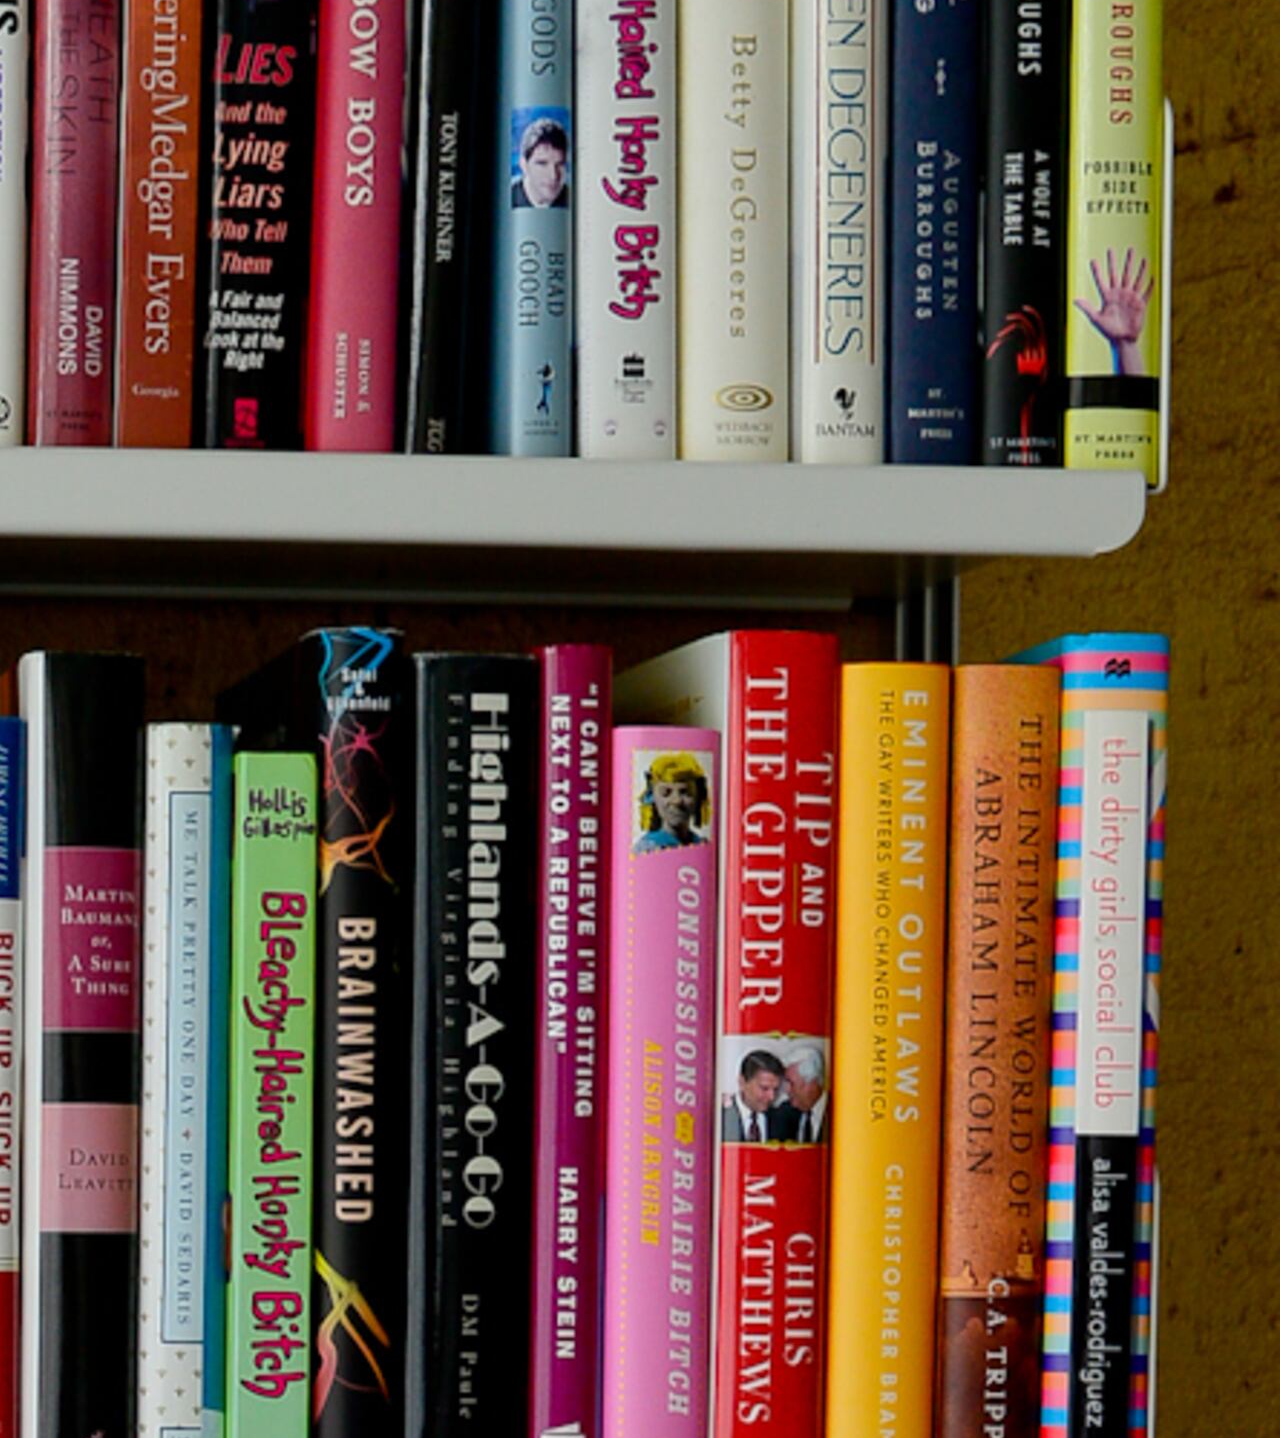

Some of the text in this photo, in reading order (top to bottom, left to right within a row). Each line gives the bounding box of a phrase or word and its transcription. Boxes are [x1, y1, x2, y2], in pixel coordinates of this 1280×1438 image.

[345, 99, 376, 208] BOYS
[824, 64, 867, 360] DEGENERES
[737, 668, 790, 1011] THE GIPPER
[335, 918, 376, 1224] BRAINWASHED
[879, 1166, 904, 1358] CHRISTOPHER
[984, 1277, 1012, 1340] C.A.
